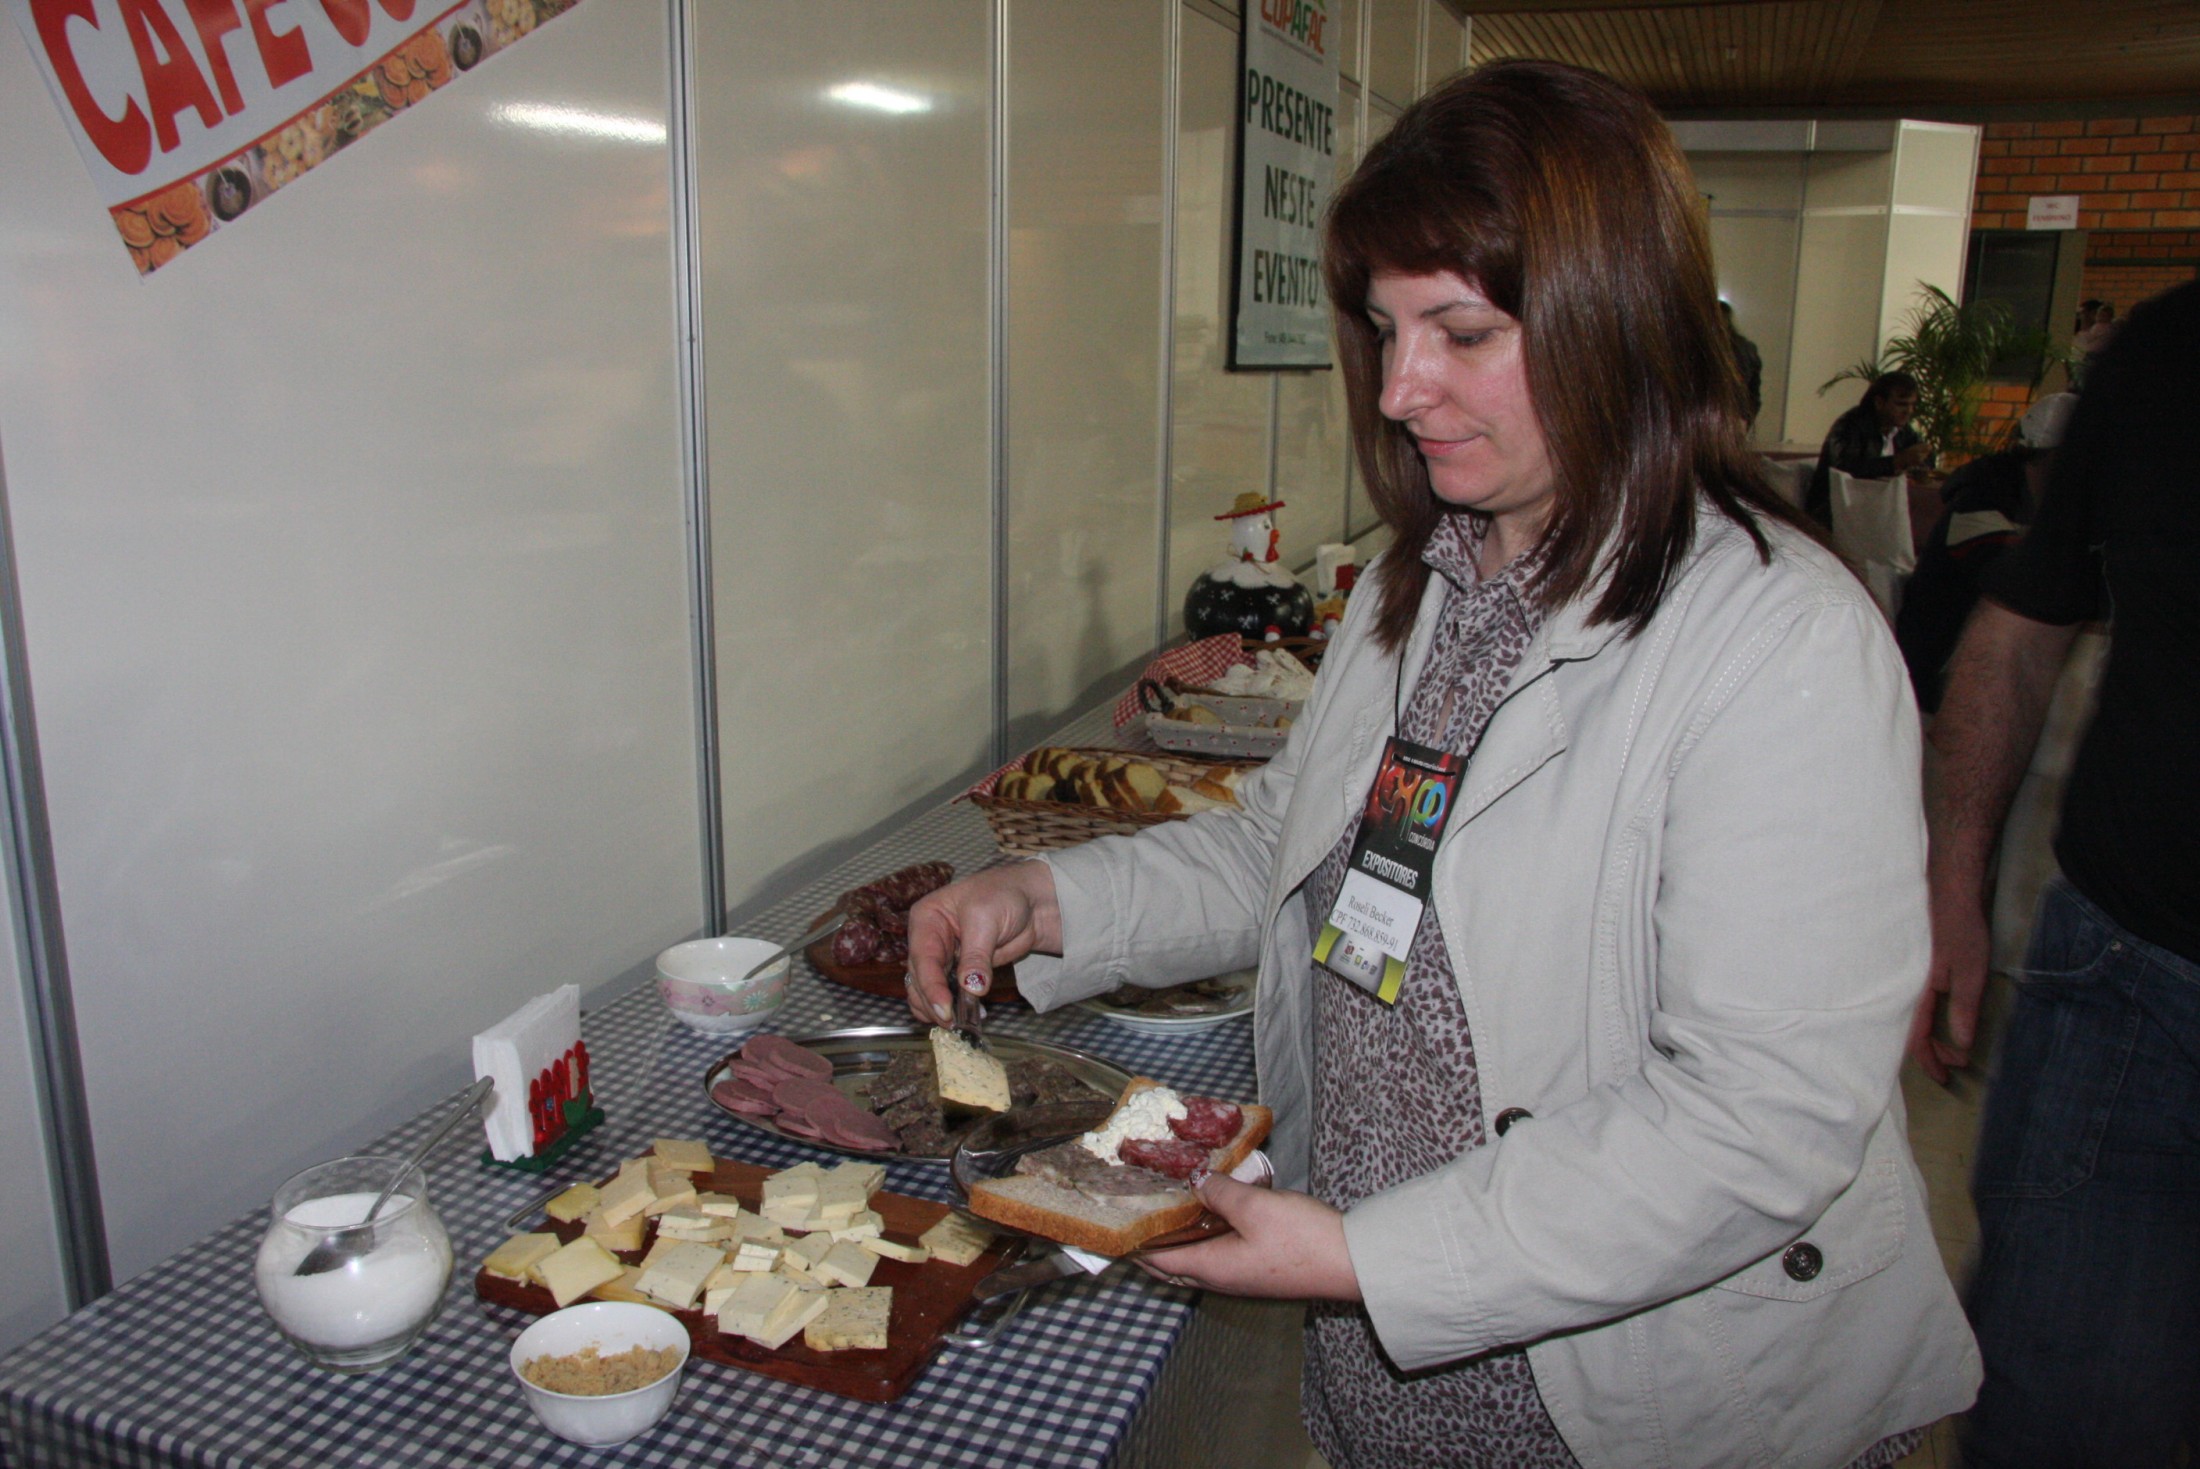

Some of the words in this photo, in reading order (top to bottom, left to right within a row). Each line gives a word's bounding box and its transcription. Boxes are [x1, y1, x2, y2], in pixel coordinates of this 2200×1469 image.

[1247, 68, 1333, 156] PRESENTE
[1264, 164, 1316, 229] NESTE
[1253, 248, 1319, 309] EVENTO
[1361, 849, 1419, 890] EXPOSITORES
[1331, 908, 1349, 925] CPF
[1347, 895, 1371, 915] Roseli
[1368, 905, 1395, 927] Becker
